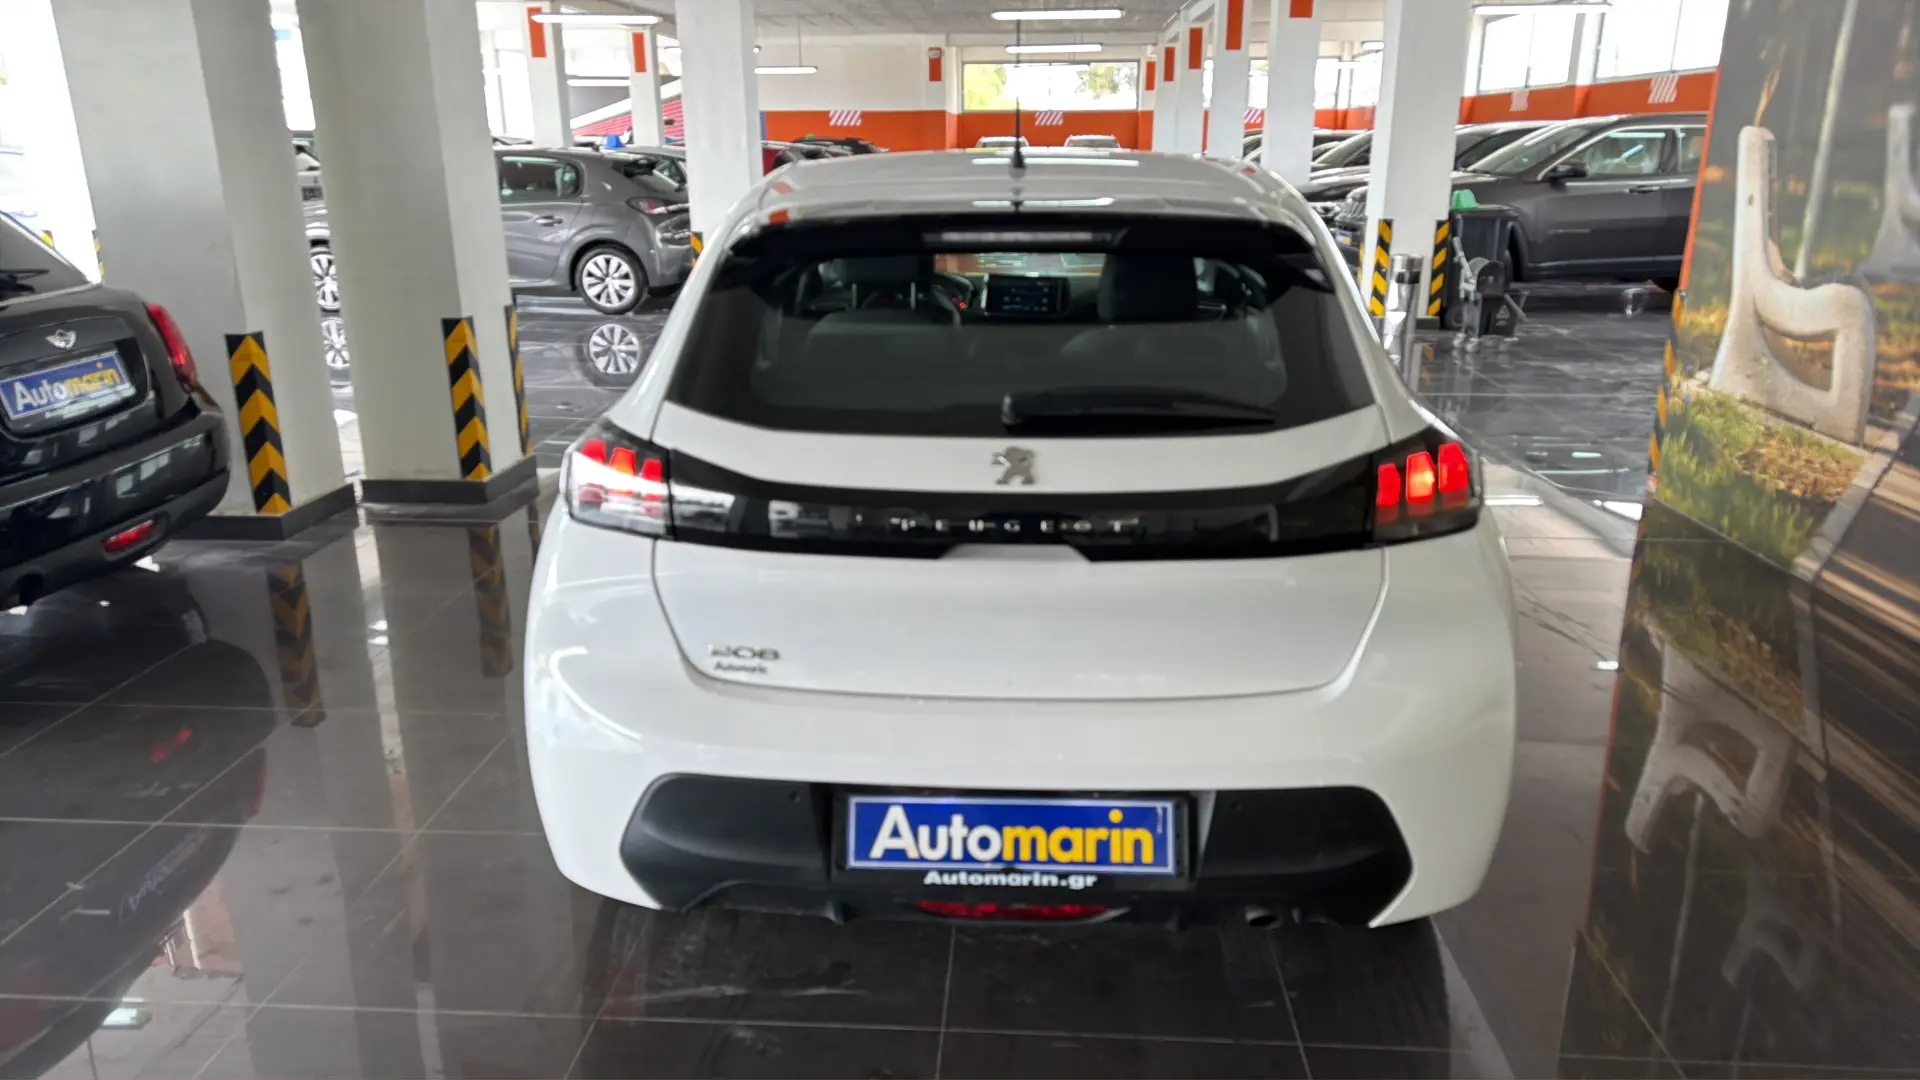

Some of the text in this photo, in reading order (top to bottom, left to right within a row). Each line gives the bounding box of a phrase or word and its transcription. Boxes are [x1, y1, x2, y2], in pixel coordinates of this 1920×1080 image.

[13, 361, 121, 412] Automarin
[869, 804, 1154, 865] Automarin
[923, 869, 1097, 891] Automarin.gr
